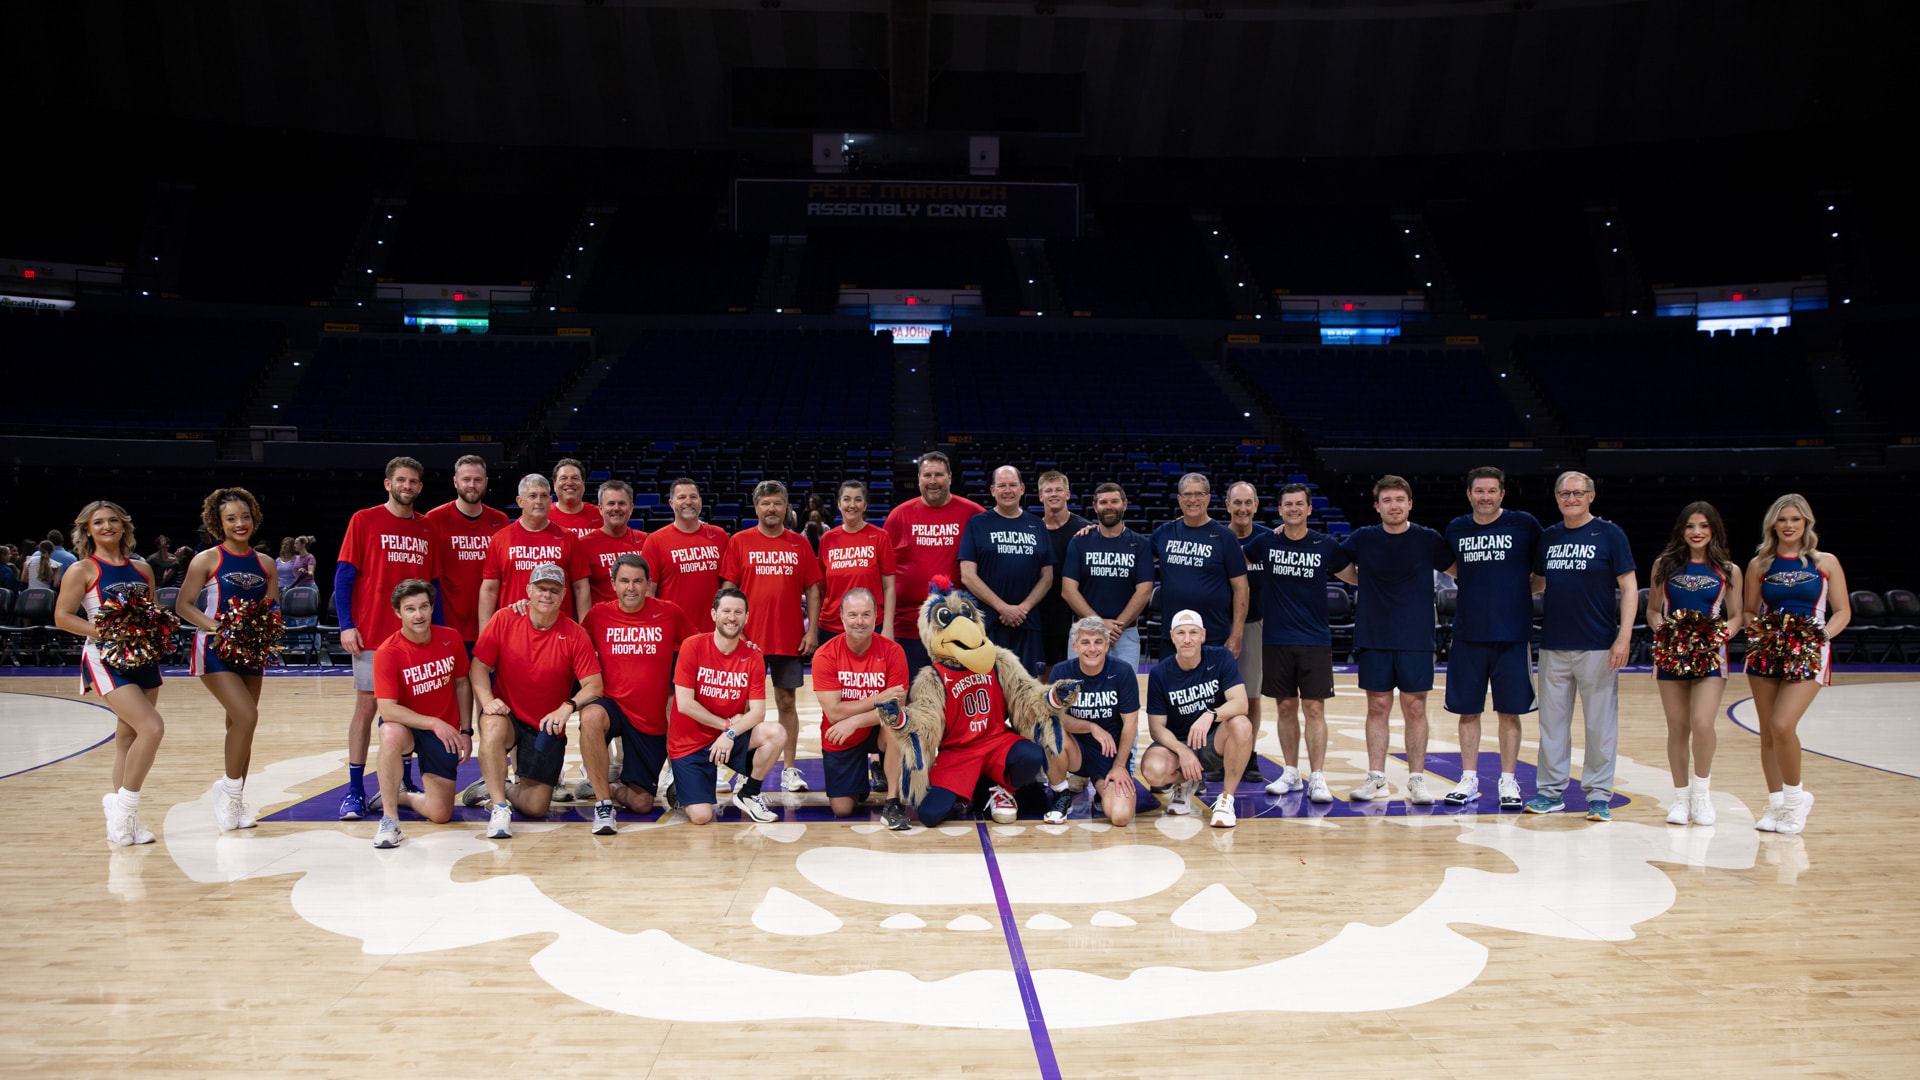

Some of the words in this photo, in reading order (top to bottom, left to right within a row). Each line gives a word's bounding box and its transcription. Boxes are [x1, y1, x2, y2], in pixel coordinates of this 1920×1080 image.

[808, 183, 872, 199] PETE
[880, 183, 1007, 201] MARAVICH
[808, 203, 921, 216] ASSEMBLY
[927, 204, 1007, 218] CENTER
[912, 523, 960, 537] PELICANS
[990, 531, 1037, 546] PELICANS
[380, 534, 429, 555] PELICANS
[1165, 540, 1213, 558] PELICANS
[1458, 535, 1513, 552] PELICANS
[1546, 544, 1597, 559] PELICANS
[508, 546, 562, 560] PELICANS
[671, 546, 720, 563] PELICANS
[749, 551, 798, 565] PELICANS
[828, 545, 875, 562] PELICANS
[1085, 552, 1136, 568] PELICANS
[1269, 549, 1322, 568] PELICANS
[606, 626, 662, 643] PELICANS
[402, 656, 455, 685] PELICANS
[697, 666, 748, 688] PELICANS
[838, 671, 885, 688] PELICANS
[951, 673, 993, 699] CRESCENT
[1169, 679, 1220, 706] PELICANS
[963, 689, 990, 717] 00
[969, 718, 989, 733] CITY
